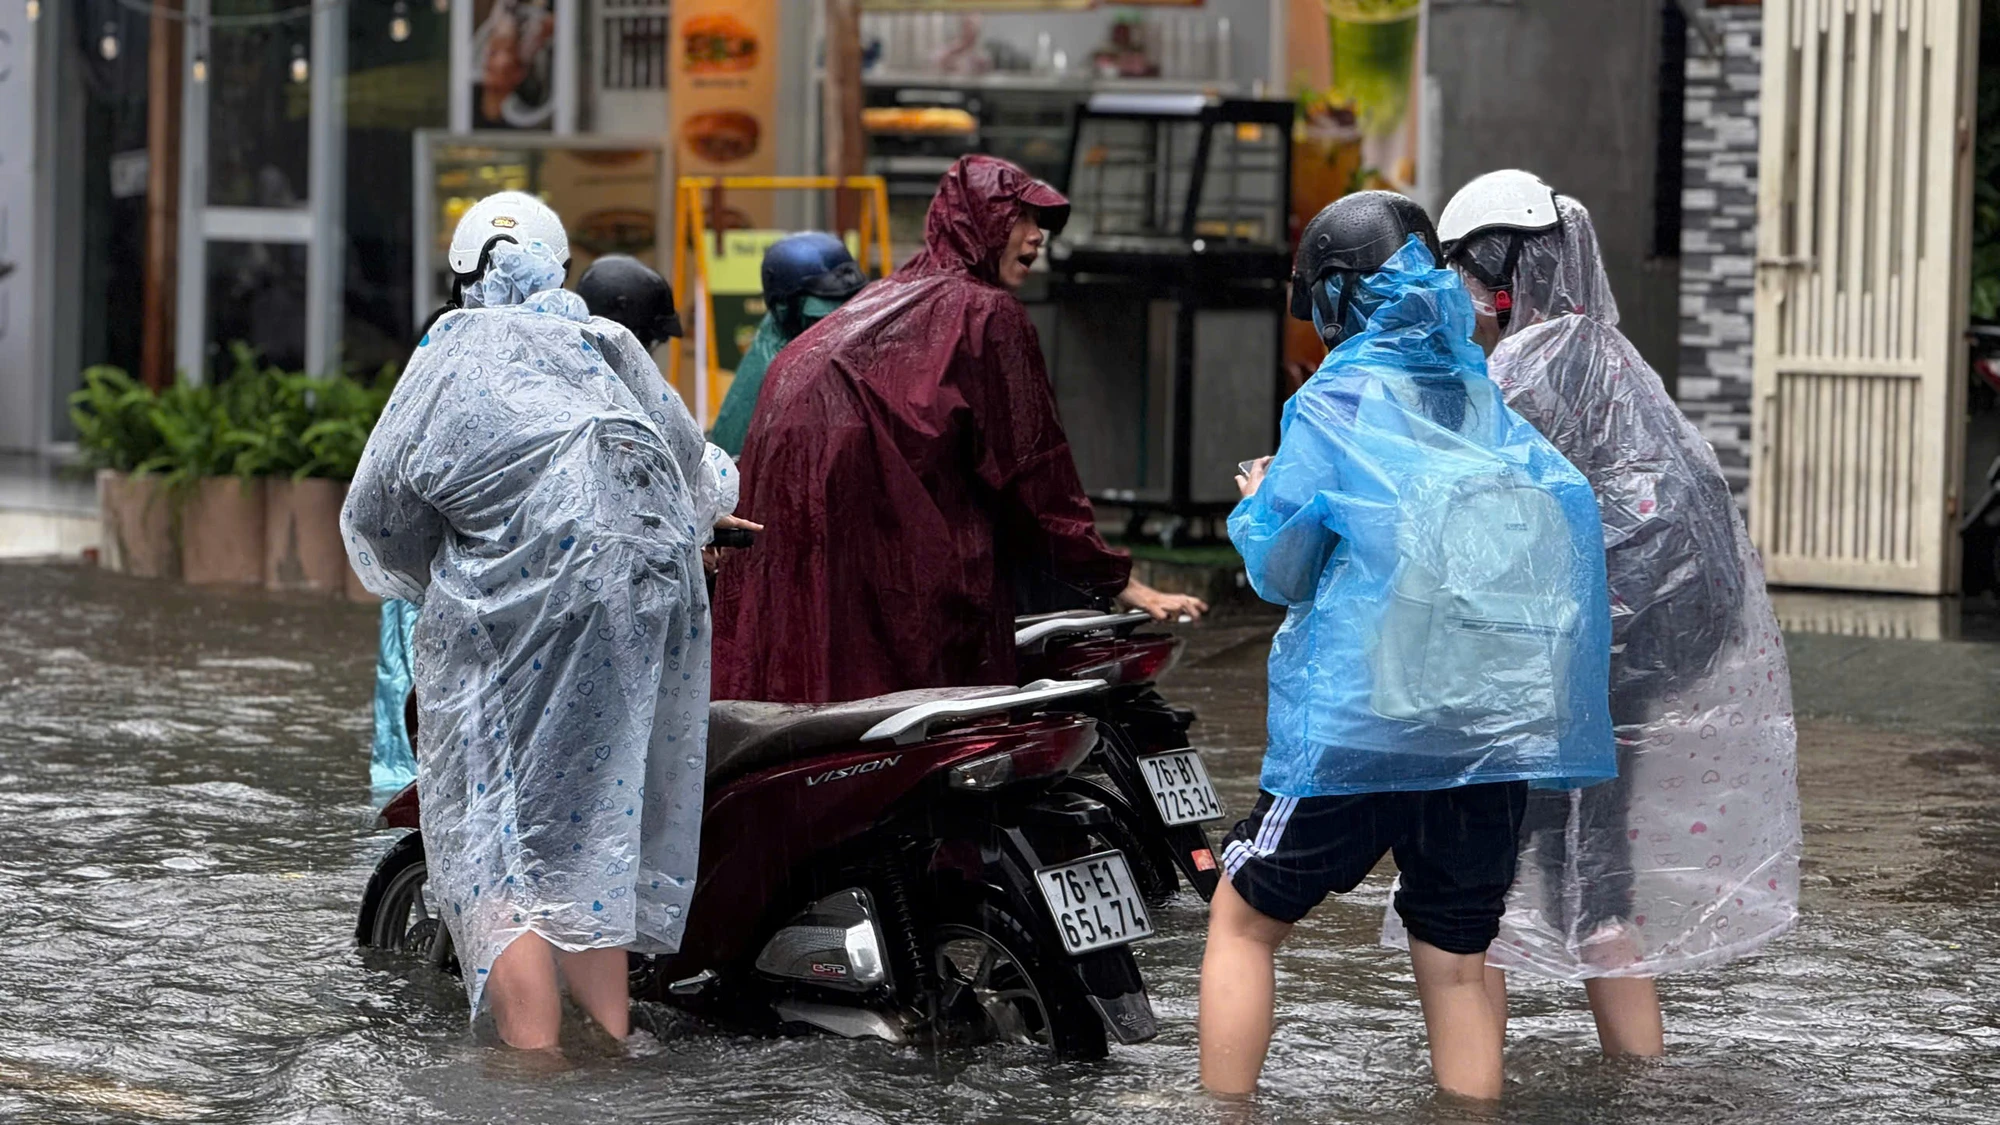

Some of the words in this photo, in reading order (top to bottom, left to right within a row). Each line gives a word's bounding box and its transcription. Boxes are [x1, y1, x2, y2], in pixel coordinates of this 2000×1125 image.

[805, 754, 902, 786] VISION
[1148, 755, 1199, 788] 76-B1
[1157, 786, 1218, 821] 725.34
[1050, 861, 1121, 908] 76-E1
[1061, 897, 1146, 947] 654.74
